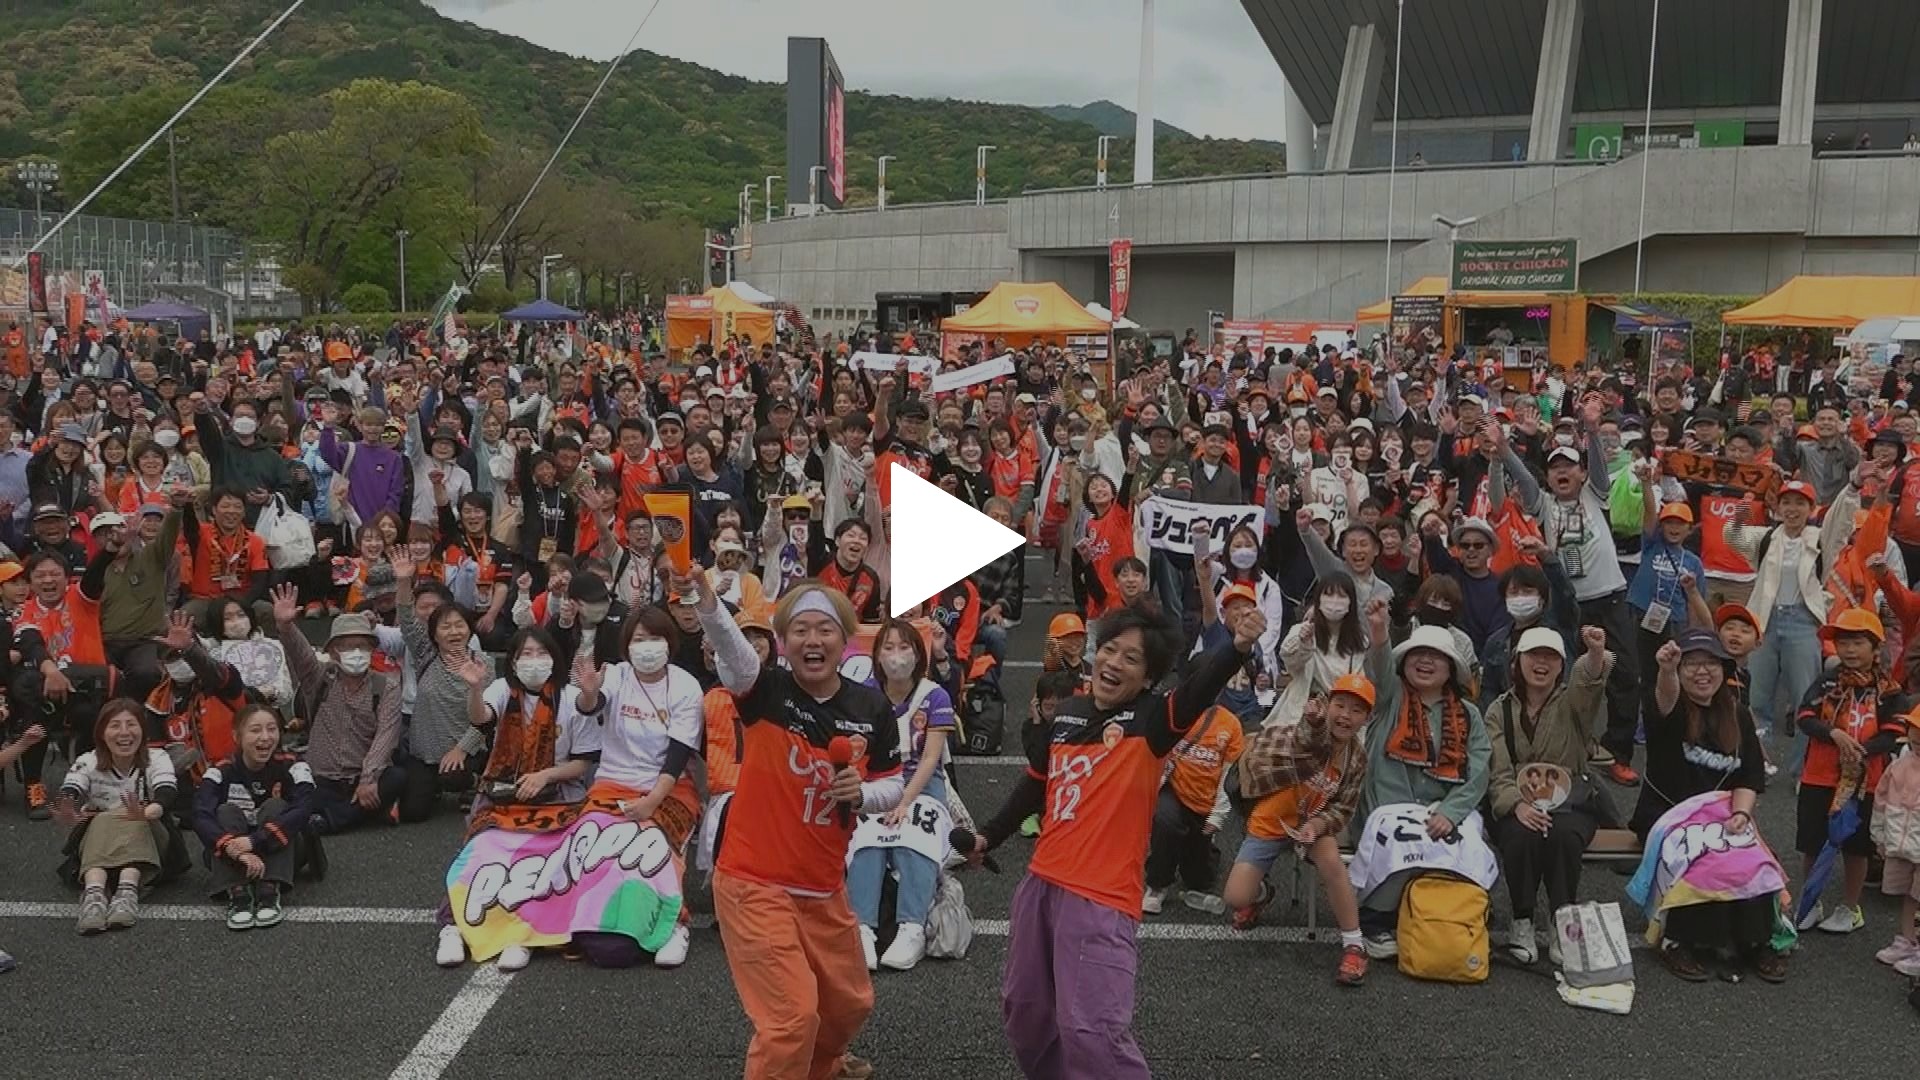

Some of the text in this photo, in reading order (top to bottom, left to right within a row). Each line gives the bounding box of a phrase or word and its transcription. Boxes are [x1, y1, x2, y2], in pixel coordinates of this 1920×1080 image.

[1108, 202, 1120, 223] 4
[1460, 257, 1569, 273] ROCKET CHICKEN
[1460, 273, 1565, 286] ORIGINAL FRIED CHICKEN
[1709, 499, 1738, 518] up
[802, 787, 838, 825] 12
[1053, 783, 1081, 821] 12
